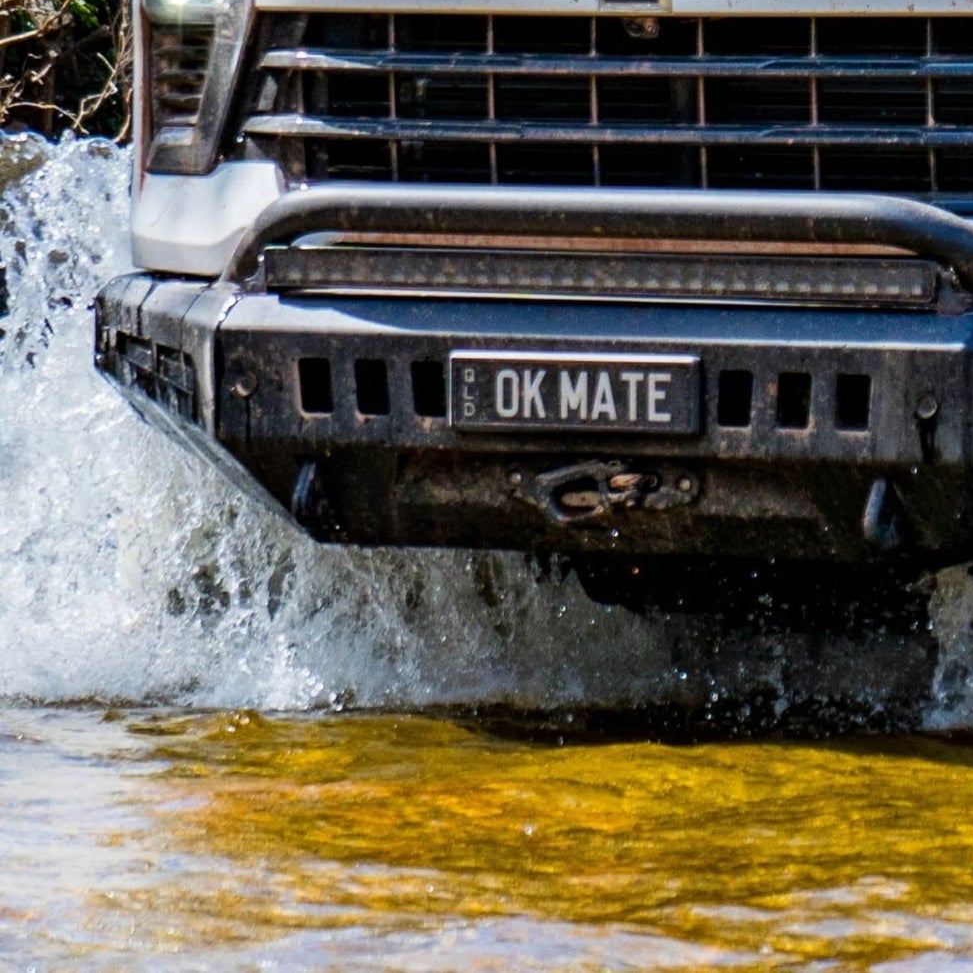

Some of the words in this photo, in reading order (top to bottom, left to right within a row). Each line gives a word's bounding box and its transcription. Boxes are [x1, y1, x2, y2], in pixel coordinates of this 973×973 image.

[463, 368, 476, 417] QLD
[495, 369, 547, 419] OK
[560, 371, 672, 422] MATE
